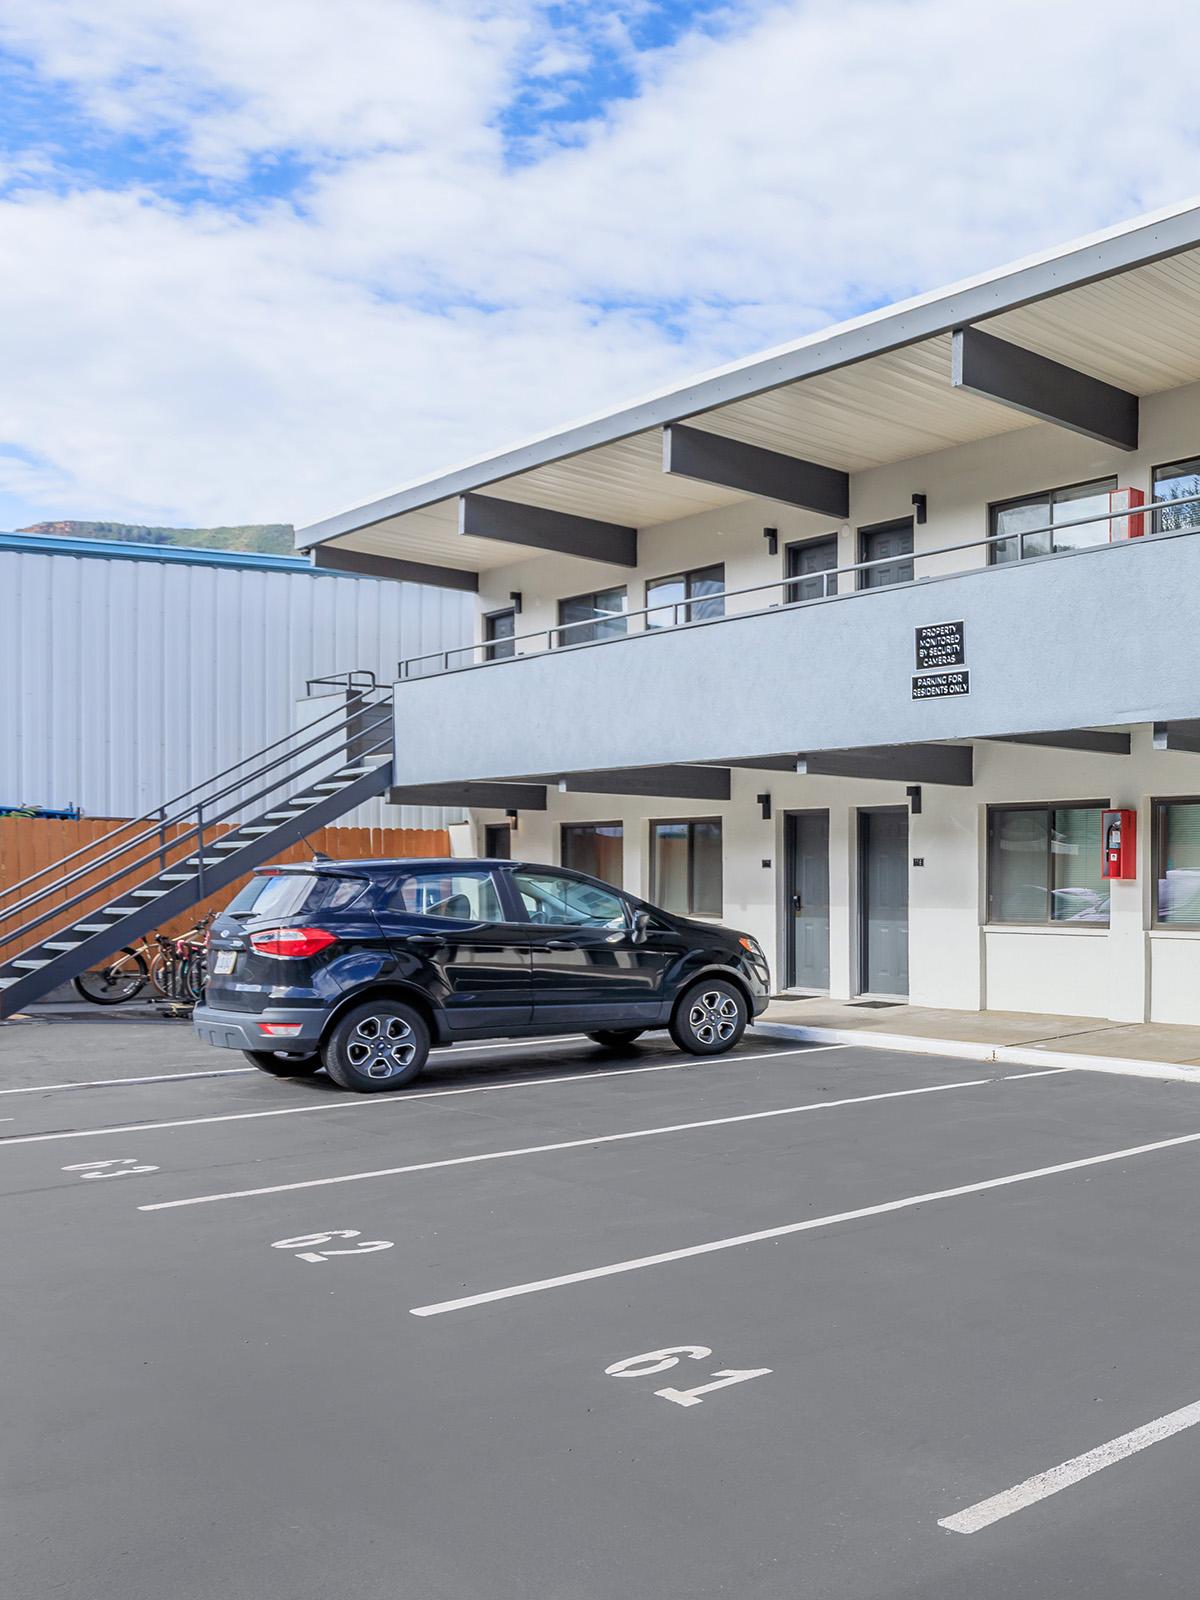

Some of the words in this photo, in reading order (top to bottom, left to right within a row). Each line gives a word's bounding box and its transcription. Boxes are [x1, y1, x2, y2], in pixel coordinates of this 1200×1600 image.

[922, 626, 956, 637] PROPERTY
[920, 635, 960, 647] MONITORED
[929, 645, 960, 656] SECURITY
[923, 655, 956, 666] CAMERAS
[917, 676, 947, 686] PARKING
[948, 675, 962, 683] FOR
[913, 685, 948, 697] RESIDENTS
[949, 684, 967, 692] ONLY
[60, 1158, 160, 1179] 63
[271, 1229, 394, 1263] 62
[605, 1345, 773, 1407] 61
